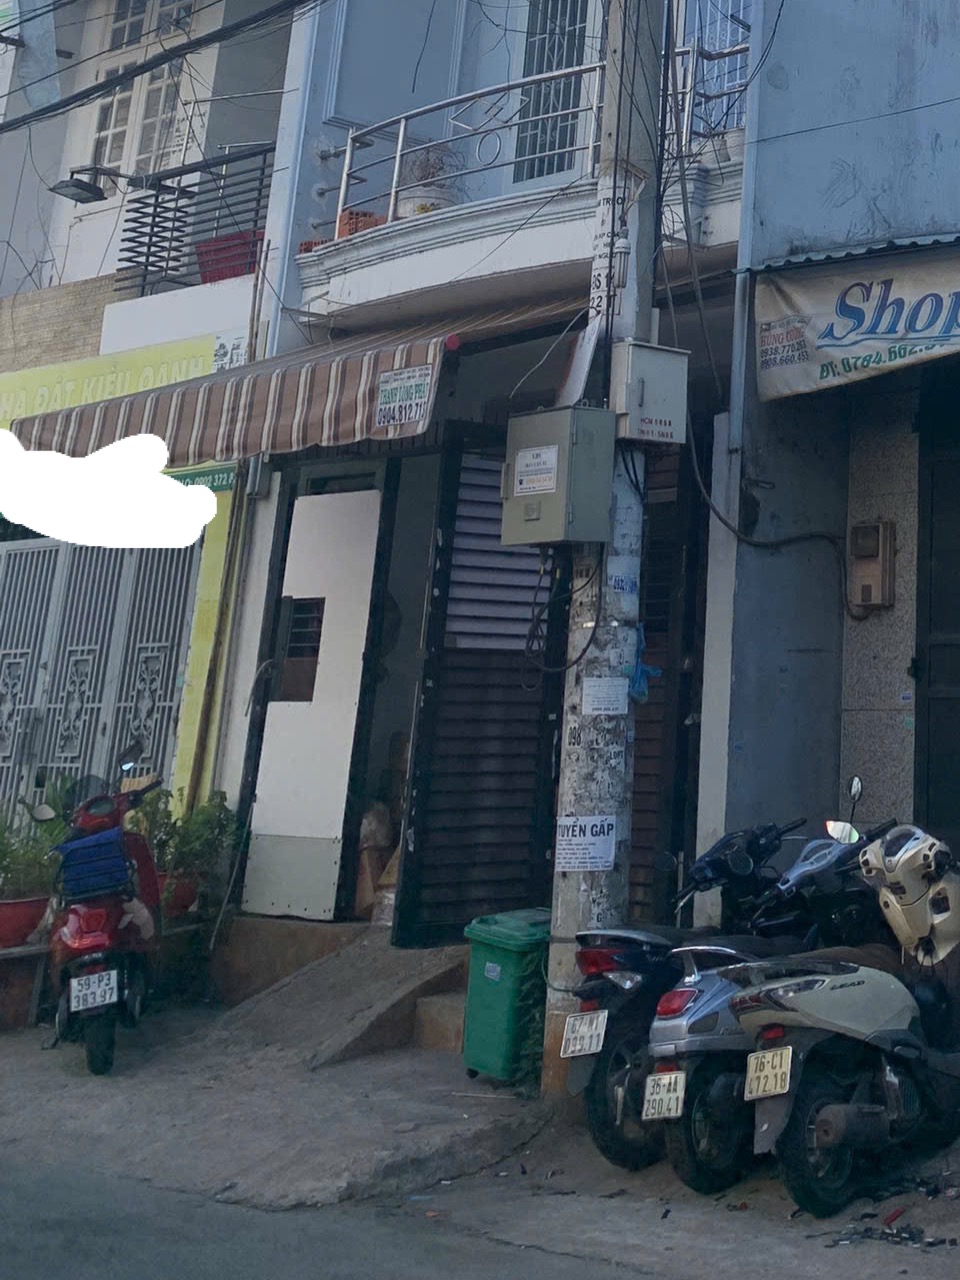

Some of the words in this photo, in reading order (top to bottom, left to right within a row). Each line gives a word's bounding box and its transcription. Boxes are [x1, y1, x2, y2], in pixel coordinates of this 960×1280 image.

[558, 818, 587, 838] TUYỂN
[590, 817, 614, 837] GẤP
[77, 973, 111, 993] 59-P3
[754, 1052, 785, 1074] 76-C1
[650, 1076, 679, 1095] 36-AA
[645, 1097, 680, 1117] 290.41
